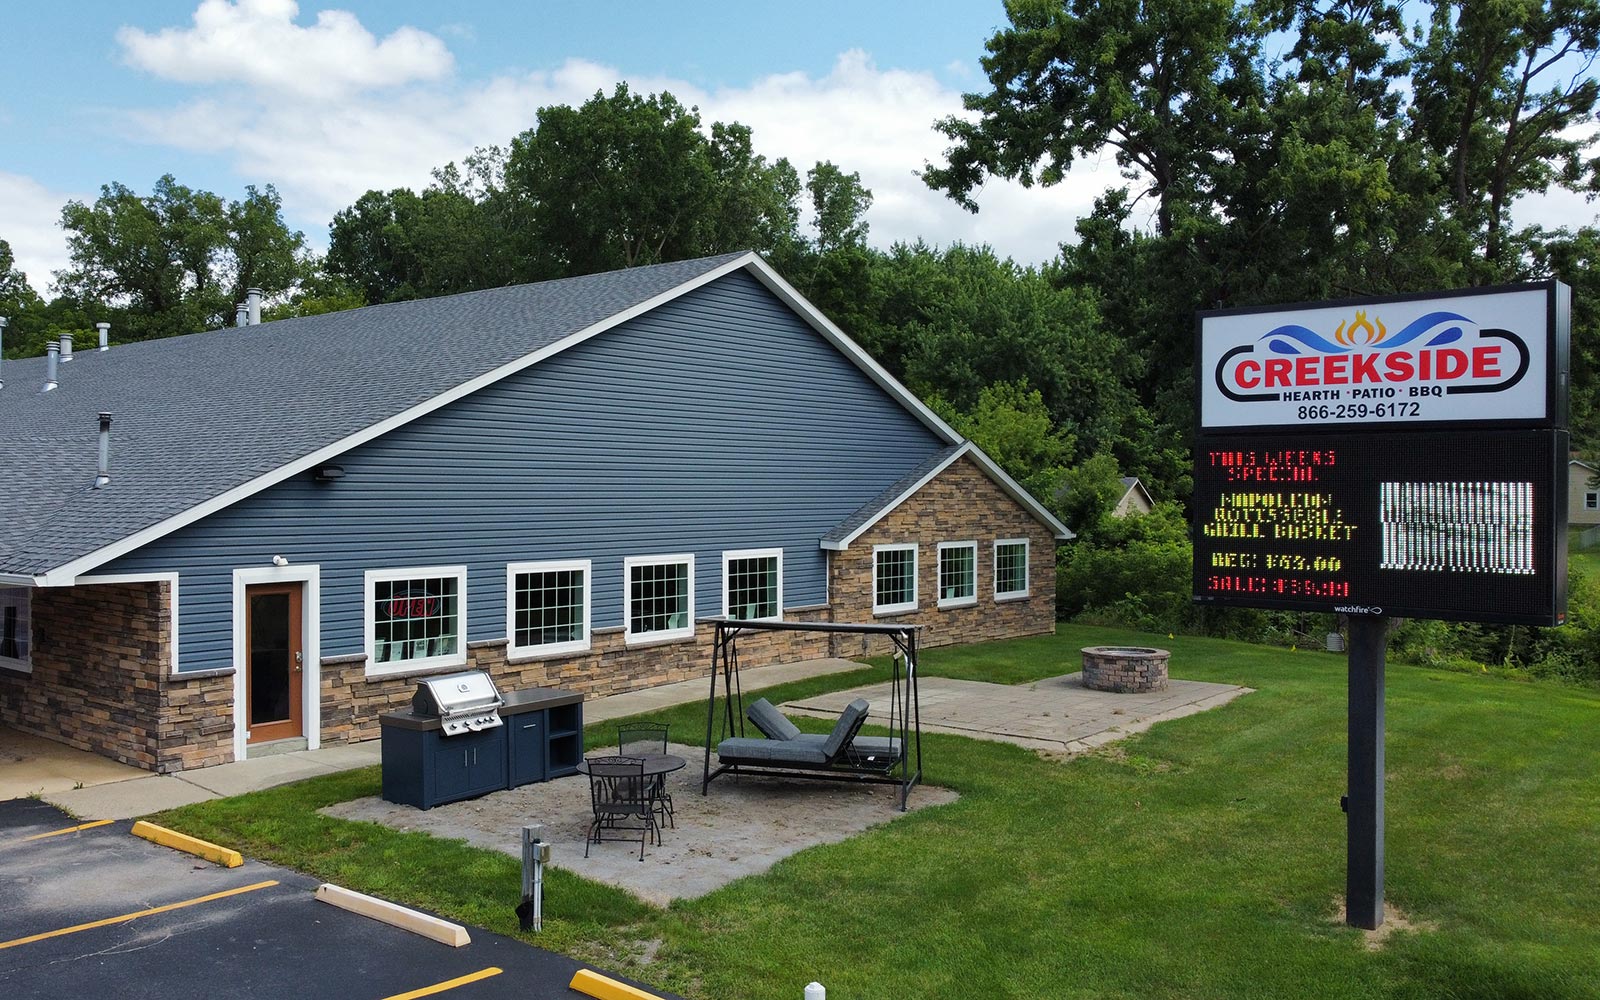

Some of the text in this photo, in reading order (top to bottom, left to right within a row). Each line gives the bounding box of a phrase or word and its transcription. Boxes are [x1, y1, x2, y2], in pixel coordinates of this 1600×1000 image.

[1235, 345, 1501, 388] CREEKSIDE
[1283, 385, 1443, 402] HEARTH PATIO BBQ
[1298, 402, 1420, 419] 866-259-6172
[1209, 450, 1335, 465] THIS WEEKS
[388, 595, 435, 617] OPEN
[1334, 605, 1370, 614] watchfire
